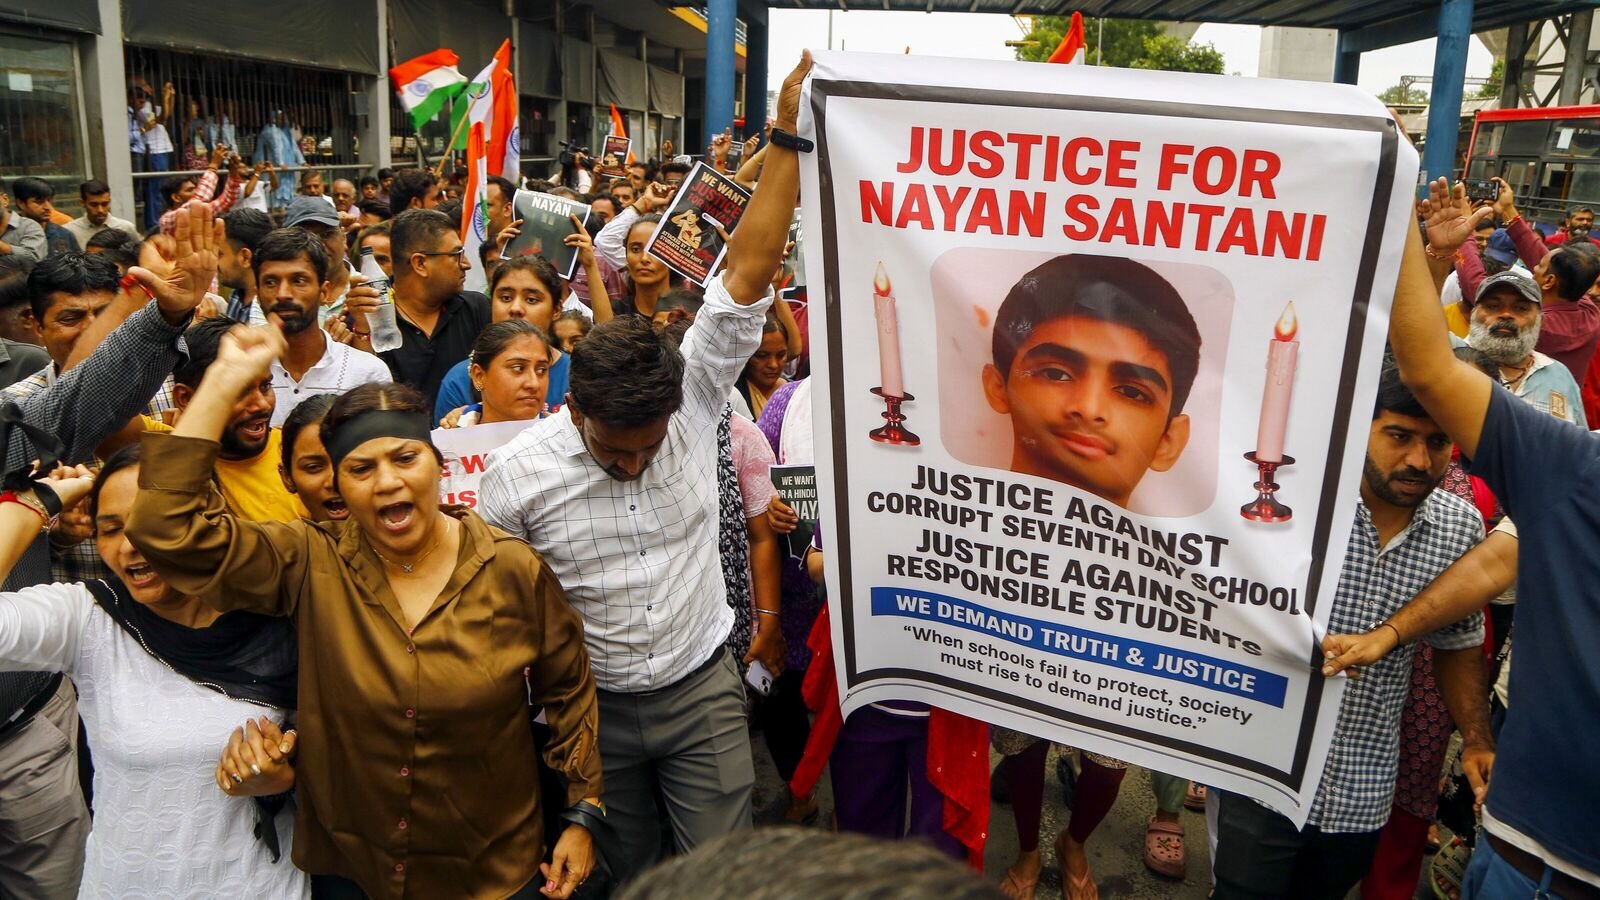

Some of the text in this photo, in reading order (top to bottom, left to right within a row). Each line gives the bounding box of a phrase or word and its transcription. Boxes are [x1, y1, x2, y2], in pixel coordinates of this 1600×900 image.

[688, 194, 705, 207] FOR
[691, 182, 742, 217] JUSTICE
[701, 171, 747, 206] WE WANT
[897, 127, 1281, 199] JUSTICE FOR
[532, 196, 572, 217] NAYAN
[859, 180, 1327, 261] NAYAN SANTANI
[782, 475, 814, 486] WE WANT
[787, 490, 793, 499] A
[794, 489, 816, 498] HINDU
[911, 465, 1229, 567] JUSTICE AGAINST
[867, 491, 1300, 615] CORRUPT SEVENTH DAY SCHOOL
[916, 529, 1218, 622] JUSTICE AGAINST
[887, 554, 1263, 656] RESPONSIBLE STUDENTS
[896, 594, 1257, 693] WE DEMAND TRUTH & JUSTICE
[903, 625, 1253, 725] “When schools fail to protect, society
[940, 652, 1207, 729] must rise to demand justice.”
